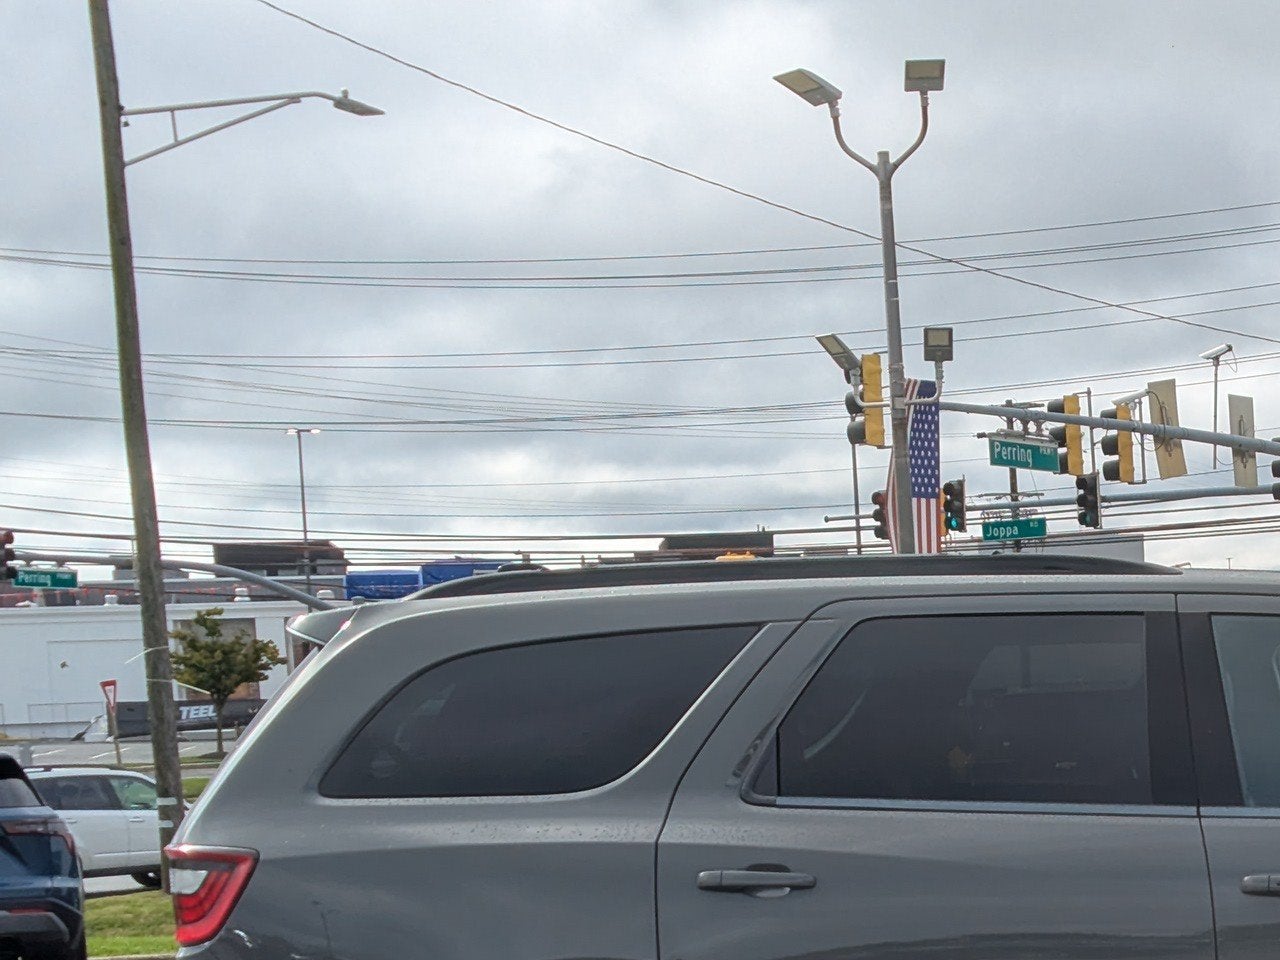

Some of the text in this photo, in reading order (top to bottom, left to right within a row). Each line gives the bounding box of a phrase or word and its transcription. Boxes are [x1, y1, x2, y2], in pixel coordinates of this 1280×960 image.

[993, 441, 1033, 468] Perring
[986, 525, 1019, 539] Joppa
[18, 571, 52, 588] Perring
